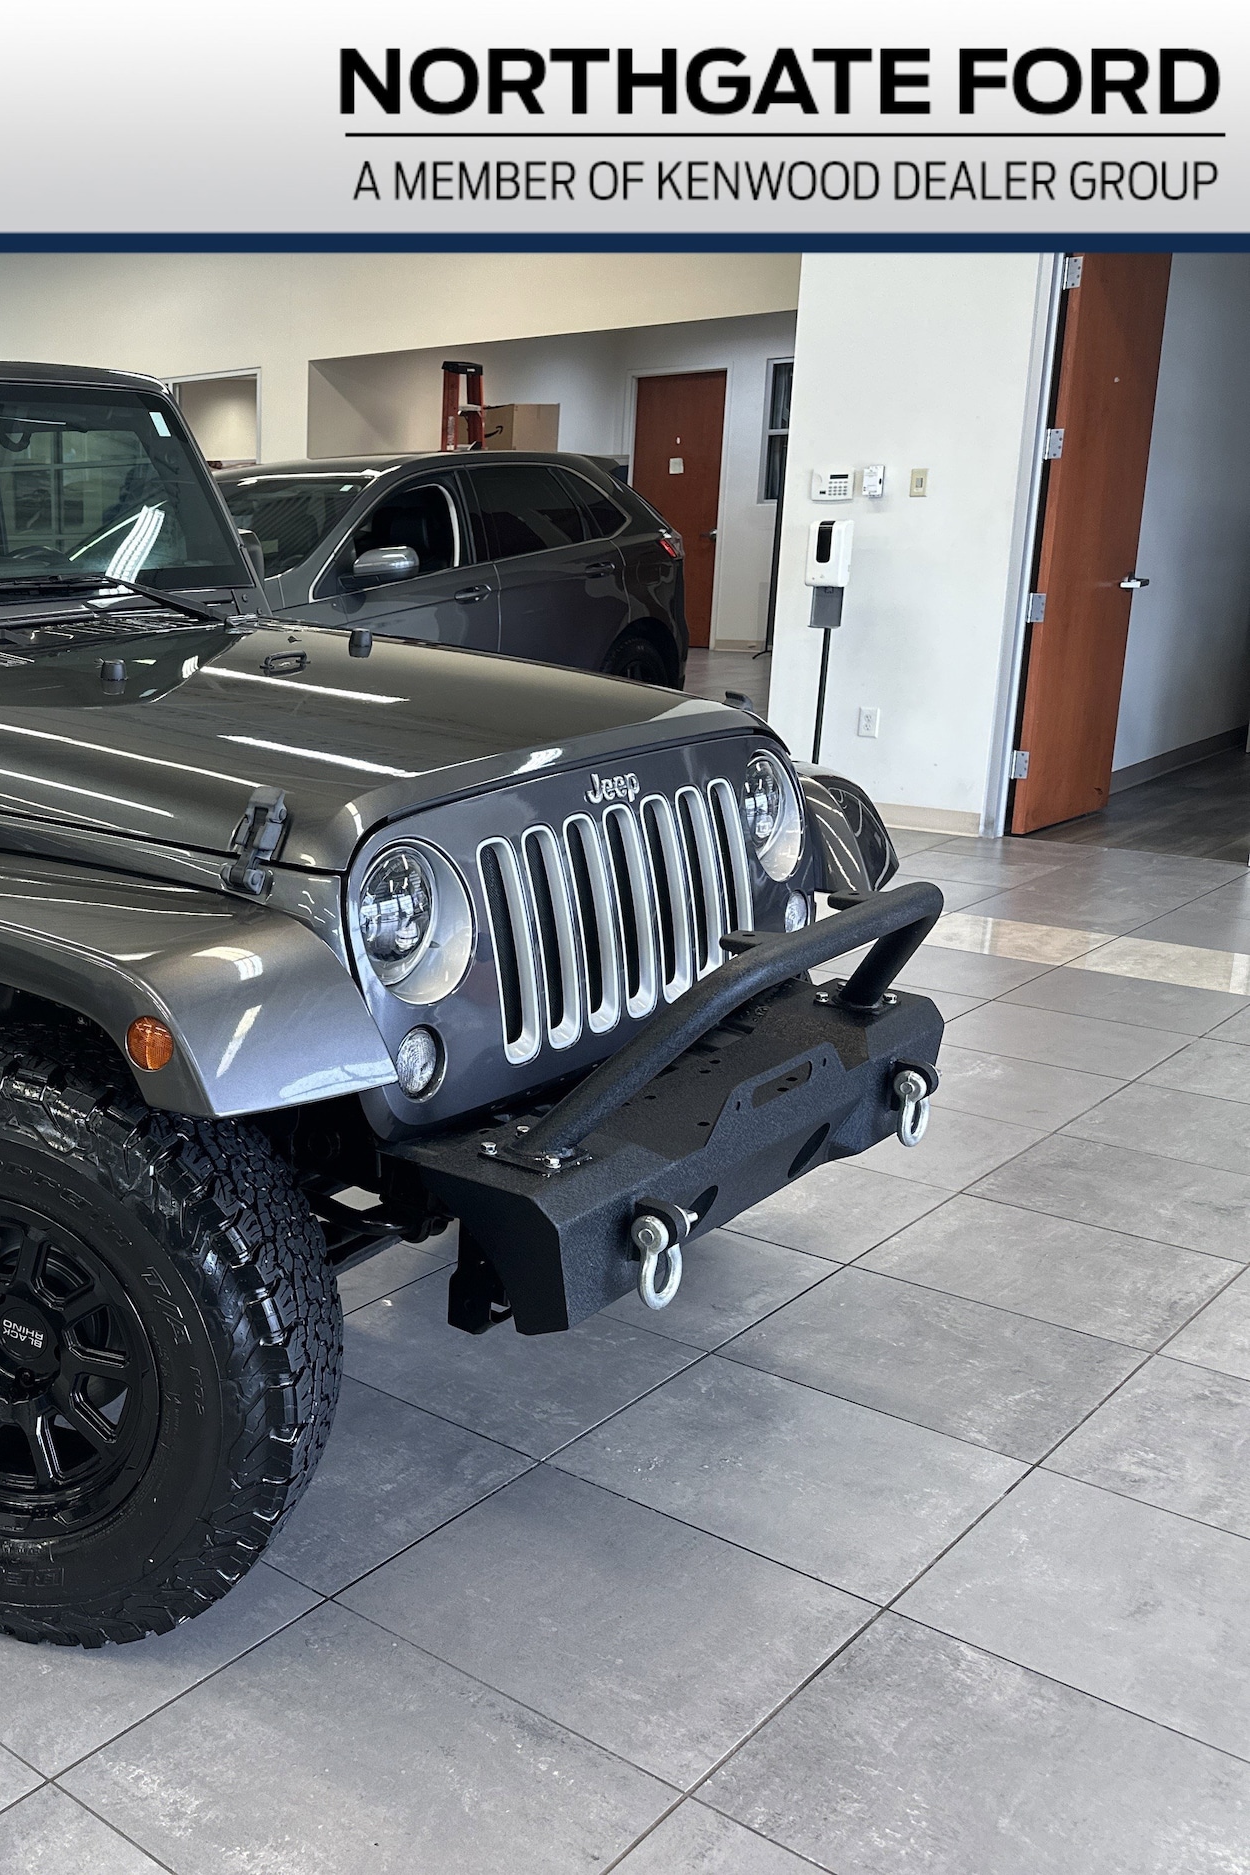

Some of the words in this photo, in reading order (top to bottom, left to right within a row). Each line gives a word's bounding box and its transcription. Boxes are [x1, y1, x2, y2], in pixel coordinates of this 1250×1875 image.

[583, 772, 640, 804] Jeep
[2, 1319, 44, 1341] RHINO
[2, 1326, 43, 1349] BLACK
